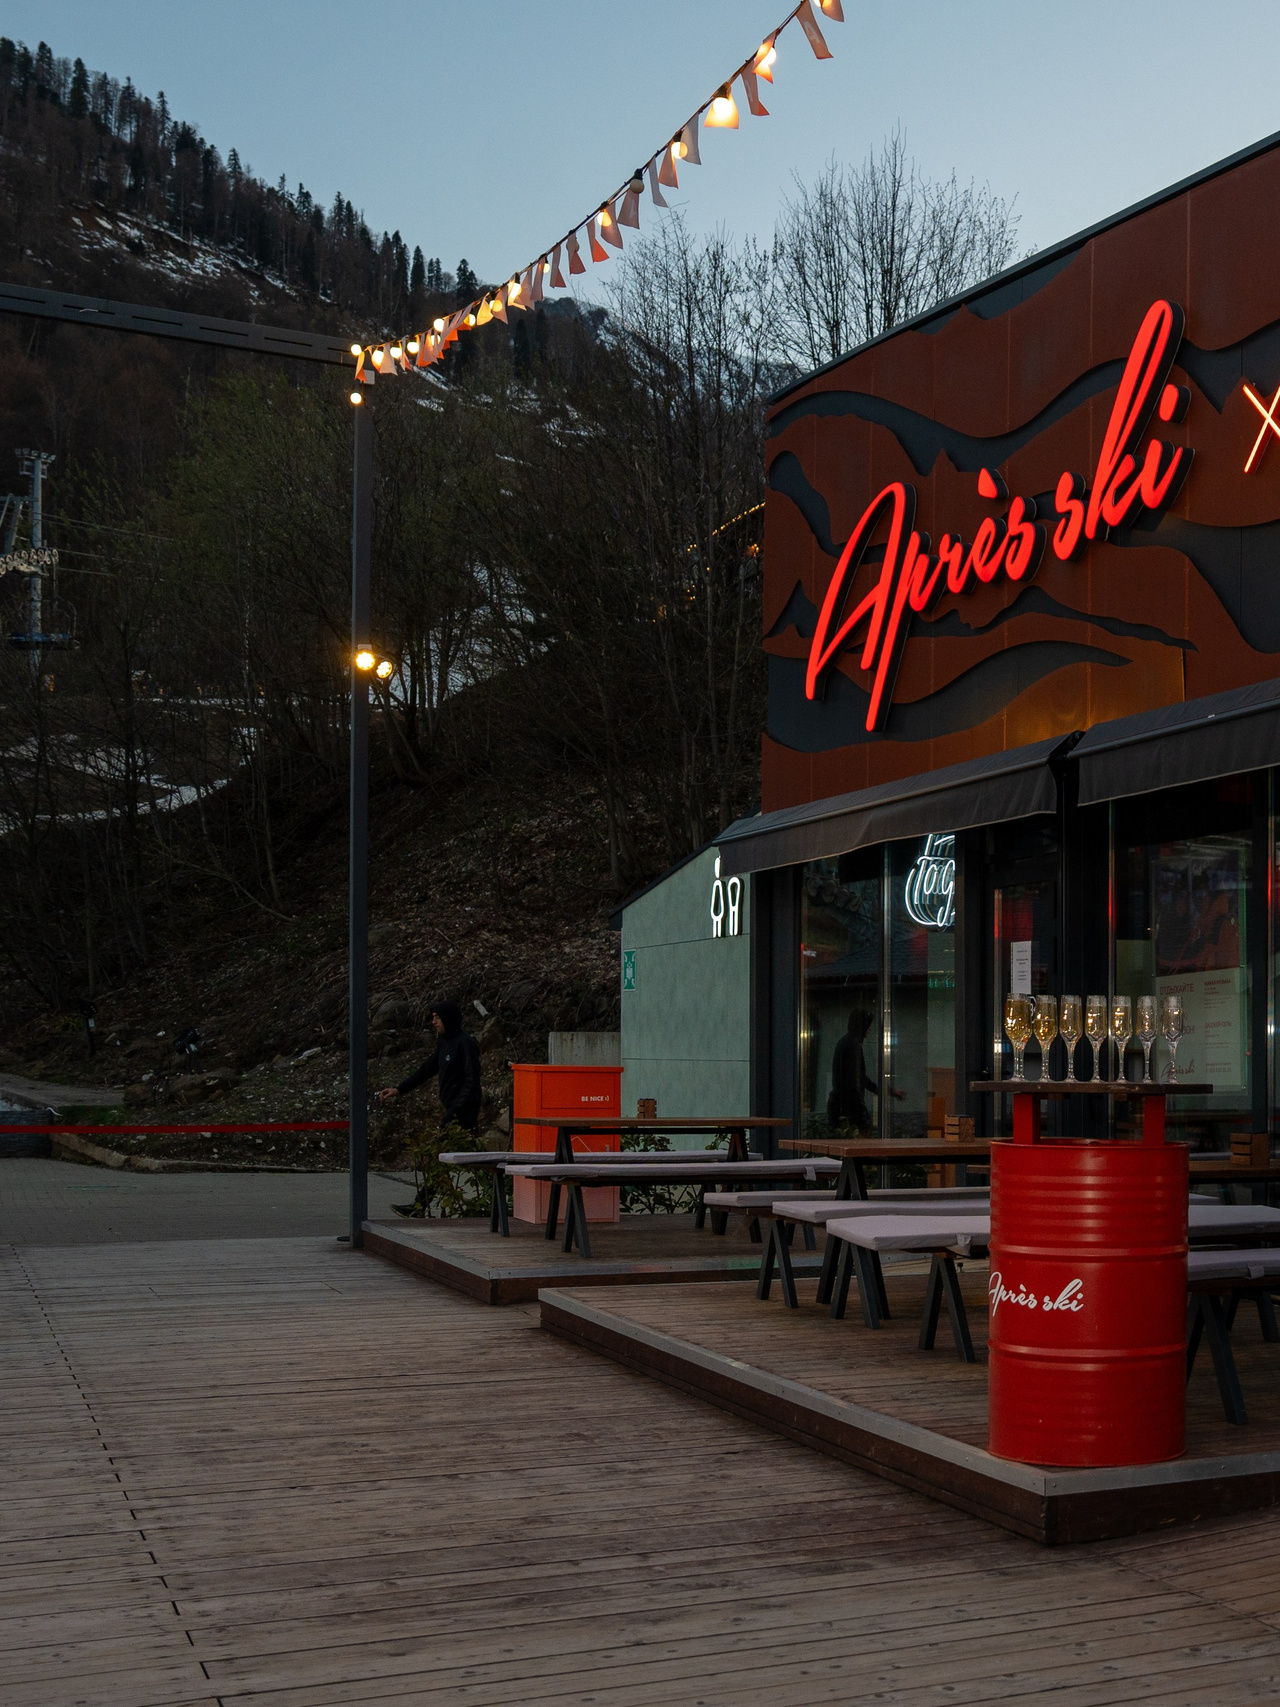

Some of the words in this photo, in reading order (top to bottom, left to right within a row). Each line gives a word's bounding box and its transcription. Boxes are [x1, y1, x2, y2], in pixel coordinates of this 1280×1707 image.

[805, 468, 1040, 732] Après
[1052, 299, 1190, 563] ski
[1160, 983, 1194, 995] ОТДЫХАЙТЕ
[988, 1271, 1038, 1317] Après
[1042, 1278, 1084, 1312] ski
